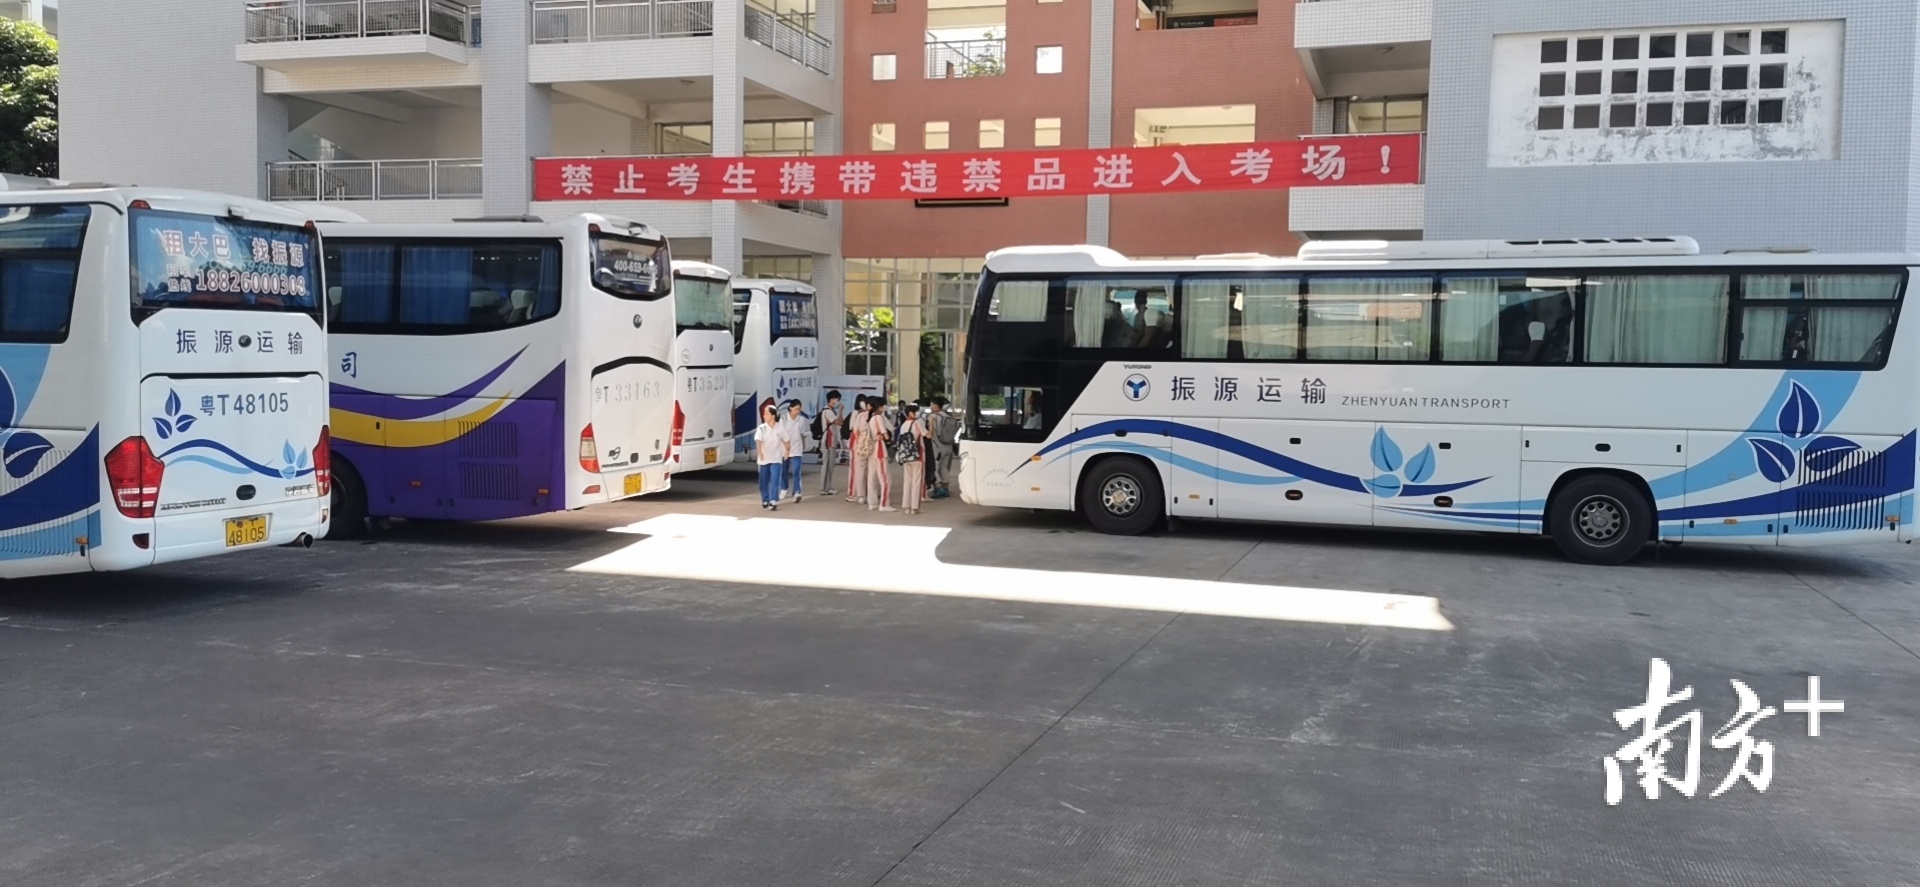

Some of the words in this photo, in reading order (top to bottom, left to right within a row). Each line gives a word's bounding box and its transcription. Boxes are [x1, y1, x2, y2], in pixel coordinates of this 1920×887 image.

[561, 144, 1391, 196] 禁止考生携带违禁品进入考场！
[163, 229, 231, 260] 租大巴
[252, 237, 304, 268] 找振源
[196, 269, 306, 296] 18826000308
[176, 328, 303, 355] 振源运输
[341, 351, 357, 379] 司
[1171, 375, 1327, 405] 振源运输
[1341, 396, 1418, 408] ZHENYUAN
[1421, 397, 1511, 409] TRANSPORT
[200, 392, 289, 416] 粤T48105
[229, 526, 265, 544] 48105
